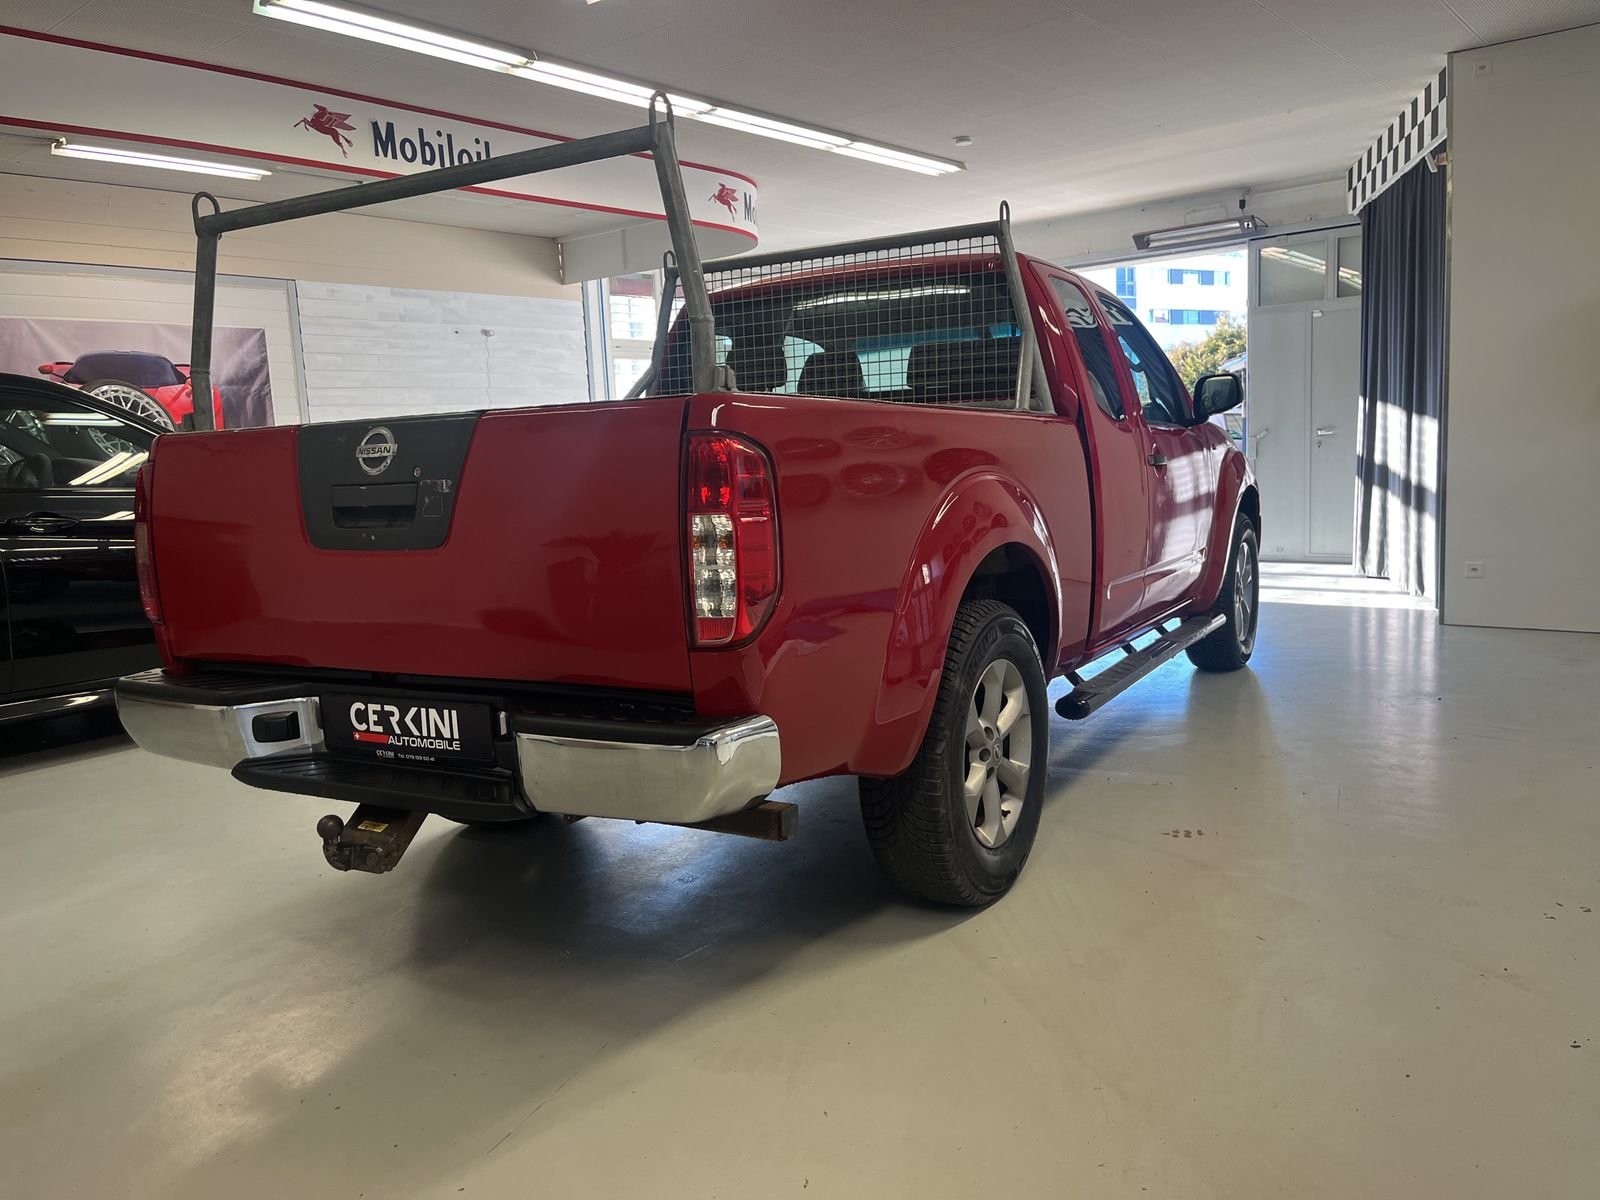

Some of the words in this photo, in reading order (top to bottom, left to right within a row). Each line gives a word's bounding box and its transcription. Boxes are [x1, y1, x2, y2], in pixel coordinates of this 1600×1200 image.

[356, 446, 391, 455] NISSAN
[349, 701, 460, 739] CERKINI
[387, 735, 461, 751] AUTOMOBILE
